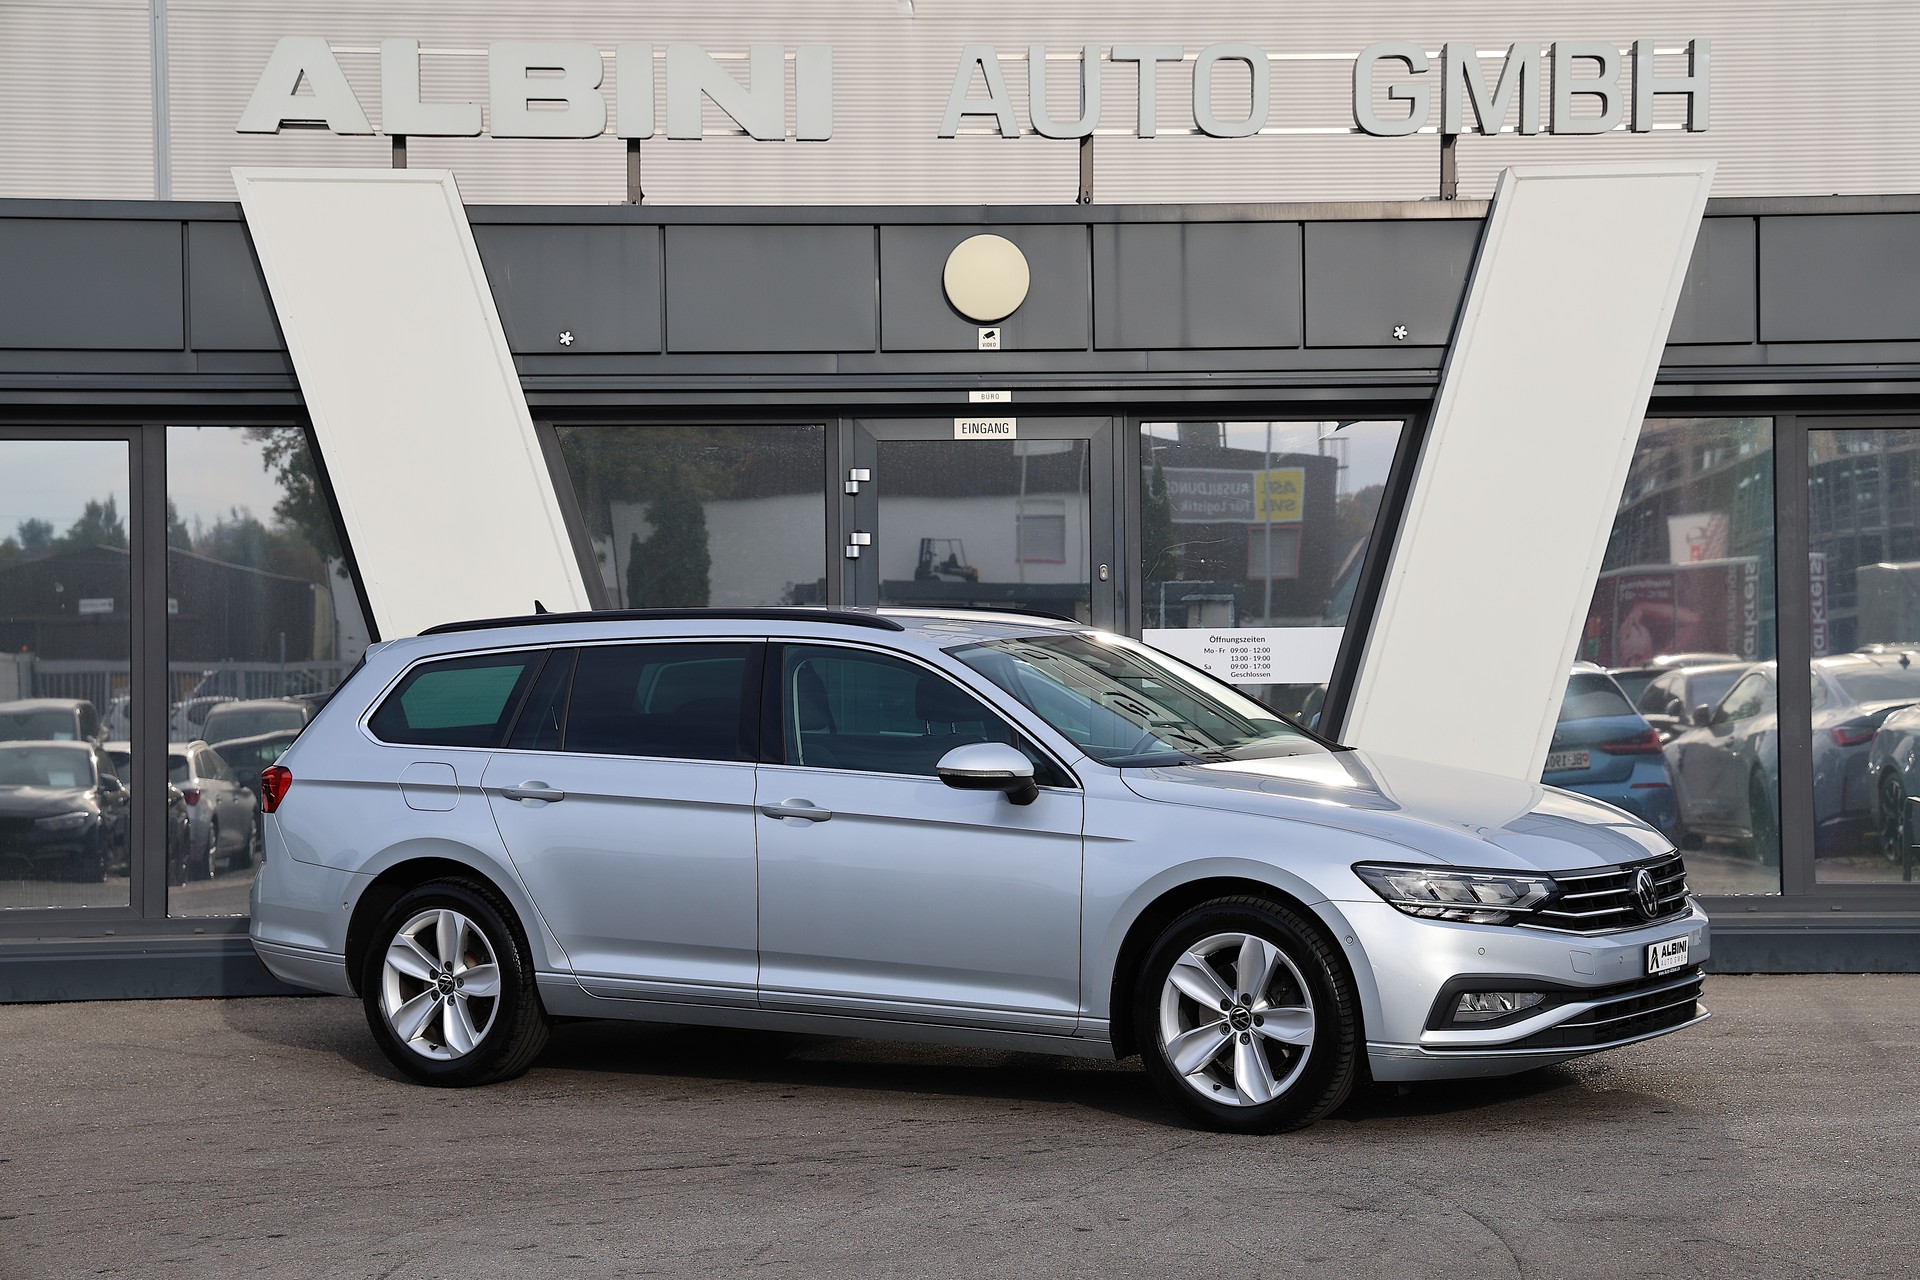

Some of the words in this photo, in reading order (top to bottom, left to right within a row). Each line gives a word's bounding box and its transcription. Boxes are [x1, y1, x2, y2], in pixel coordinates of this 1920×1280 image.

[236, 36, 833, 142] ALBINI
[937, 42, 1271, 139] AUTO
[1353, 38, 1712, 136] GMBH
[981, 392, 1000, 400] BÜRO
[962, 423, 1009, 434] EINGANG
[1209, 635, 1266, 644] Öffnungszeiten
[1661, 940, 1687, 958] ALBINI
